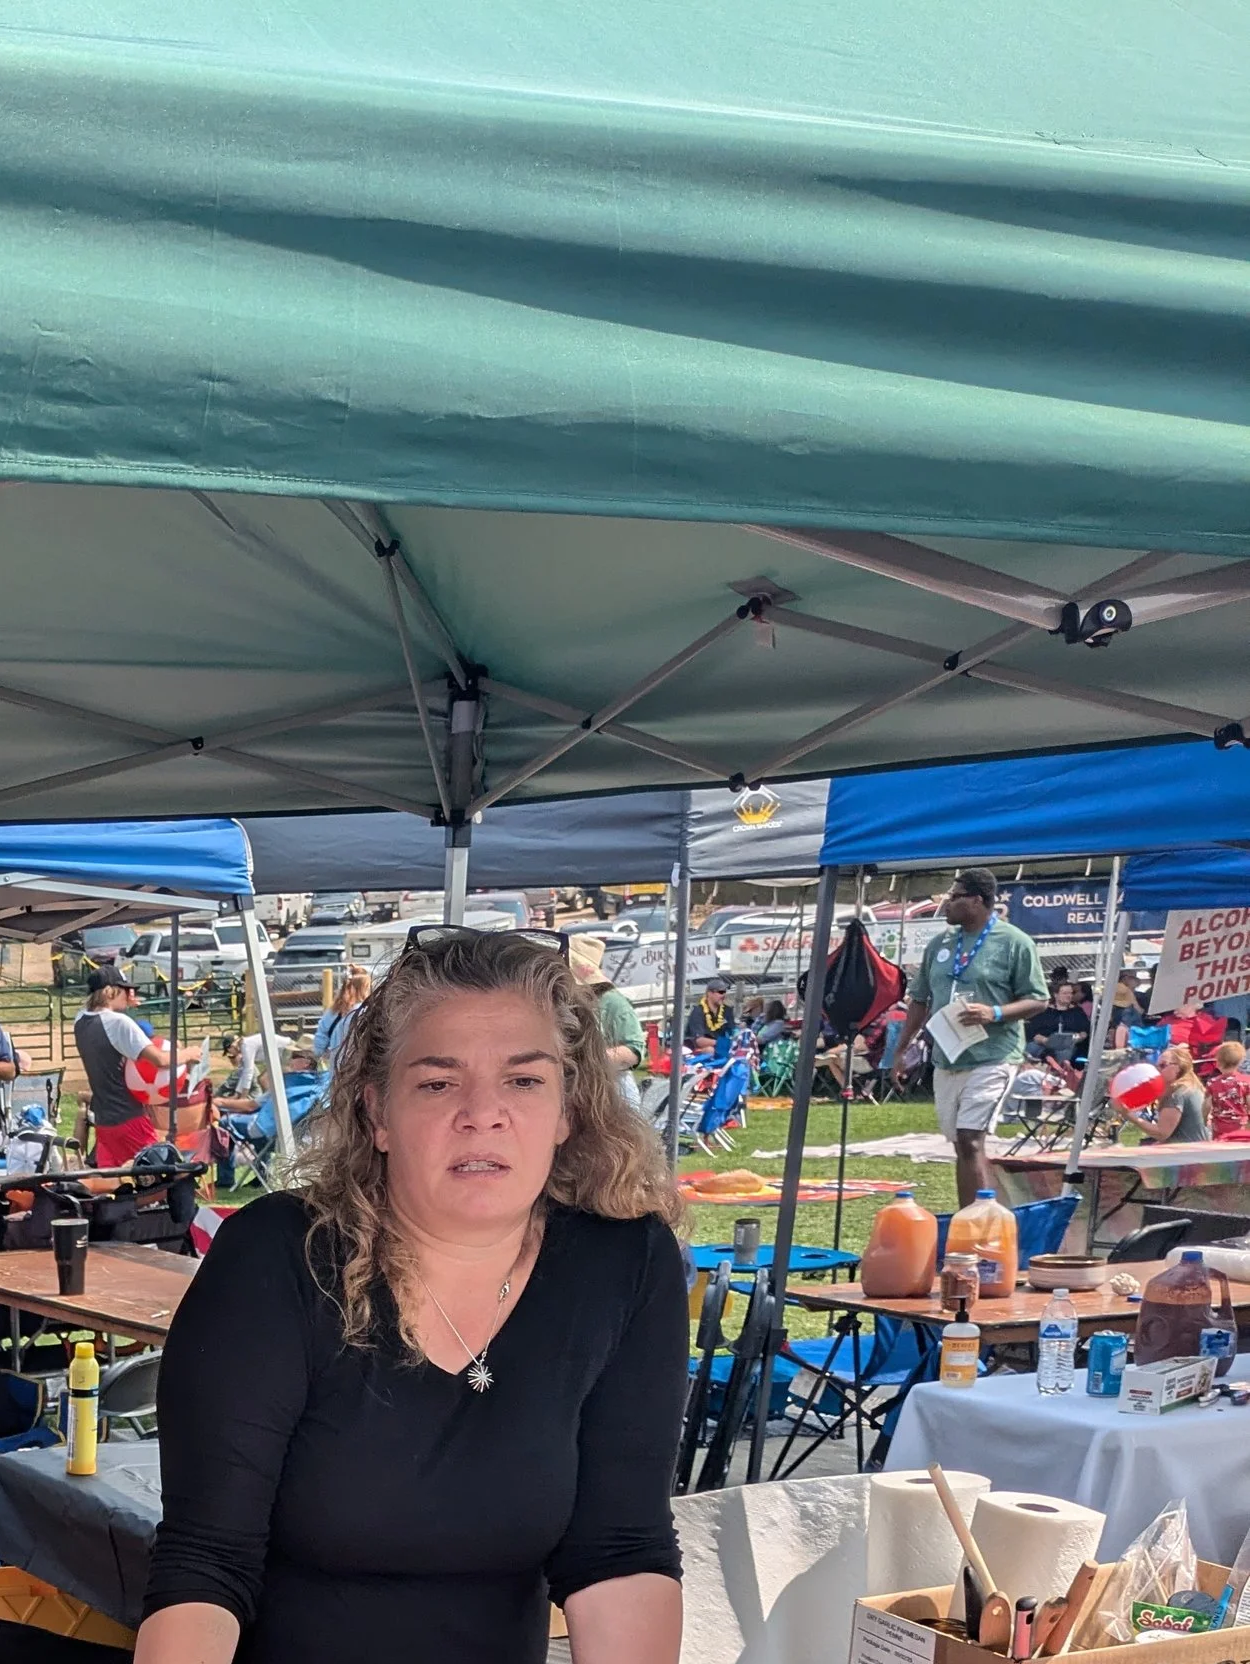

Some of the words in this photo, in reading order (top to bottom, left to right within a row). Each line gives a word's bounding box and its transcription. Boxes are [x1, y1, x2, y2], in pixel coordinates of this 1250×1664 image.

[1022, 893, 1103, 908] COLDWELL
[1195, 953, 1250, 981] THIS
[1183, 975, 1250, 1004] POINT
[1138, 1610, 1194, 1631] Sadaf
